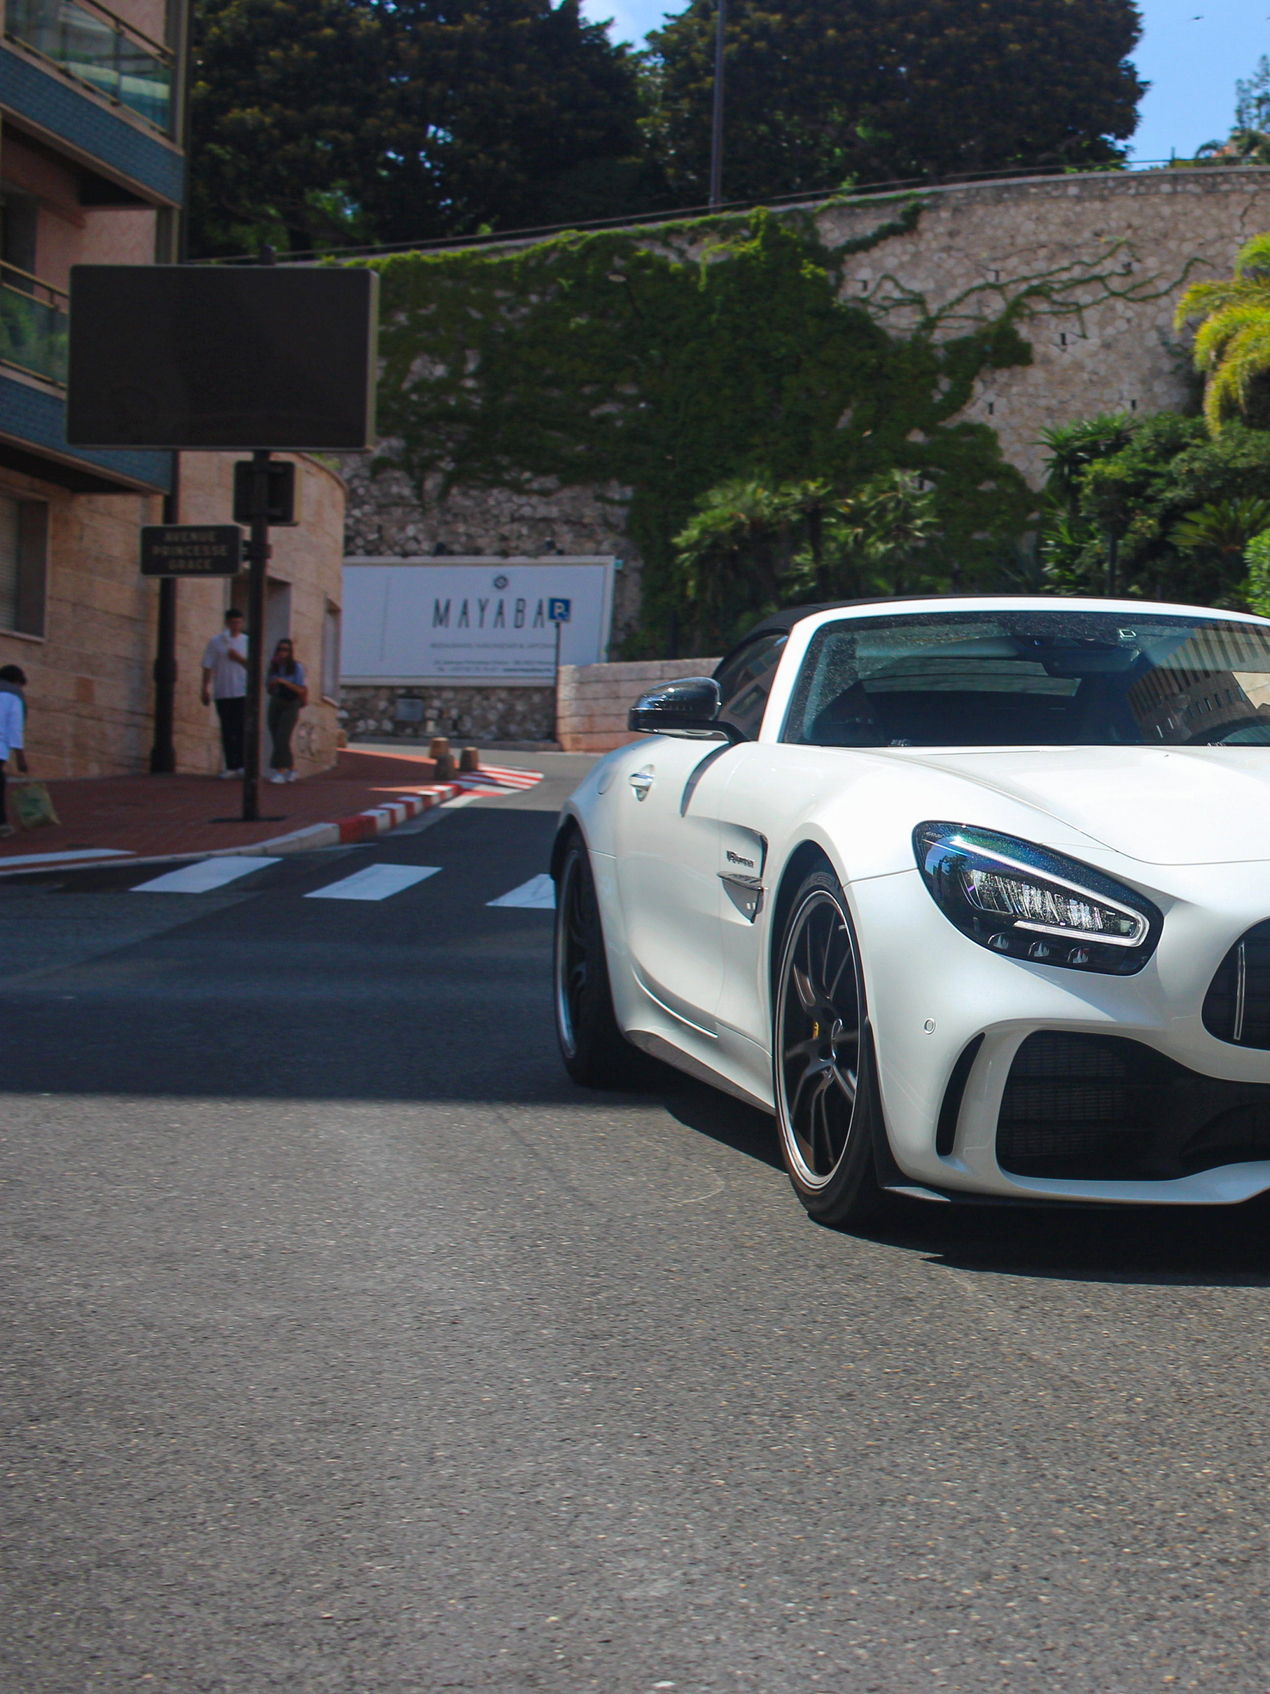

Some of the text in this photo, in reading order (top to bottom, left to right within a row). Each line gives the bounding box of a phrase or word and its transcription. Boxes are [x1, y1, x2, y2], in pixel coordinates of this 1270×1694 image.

[164, 531, 216, 542] AVENUE
[152, 545, 228, 556] PRINCESSE
[168, 559, 212, 570] GRACE
[432, 598, 546, 628] MAYABA
[554, 601, 566, 617] P
